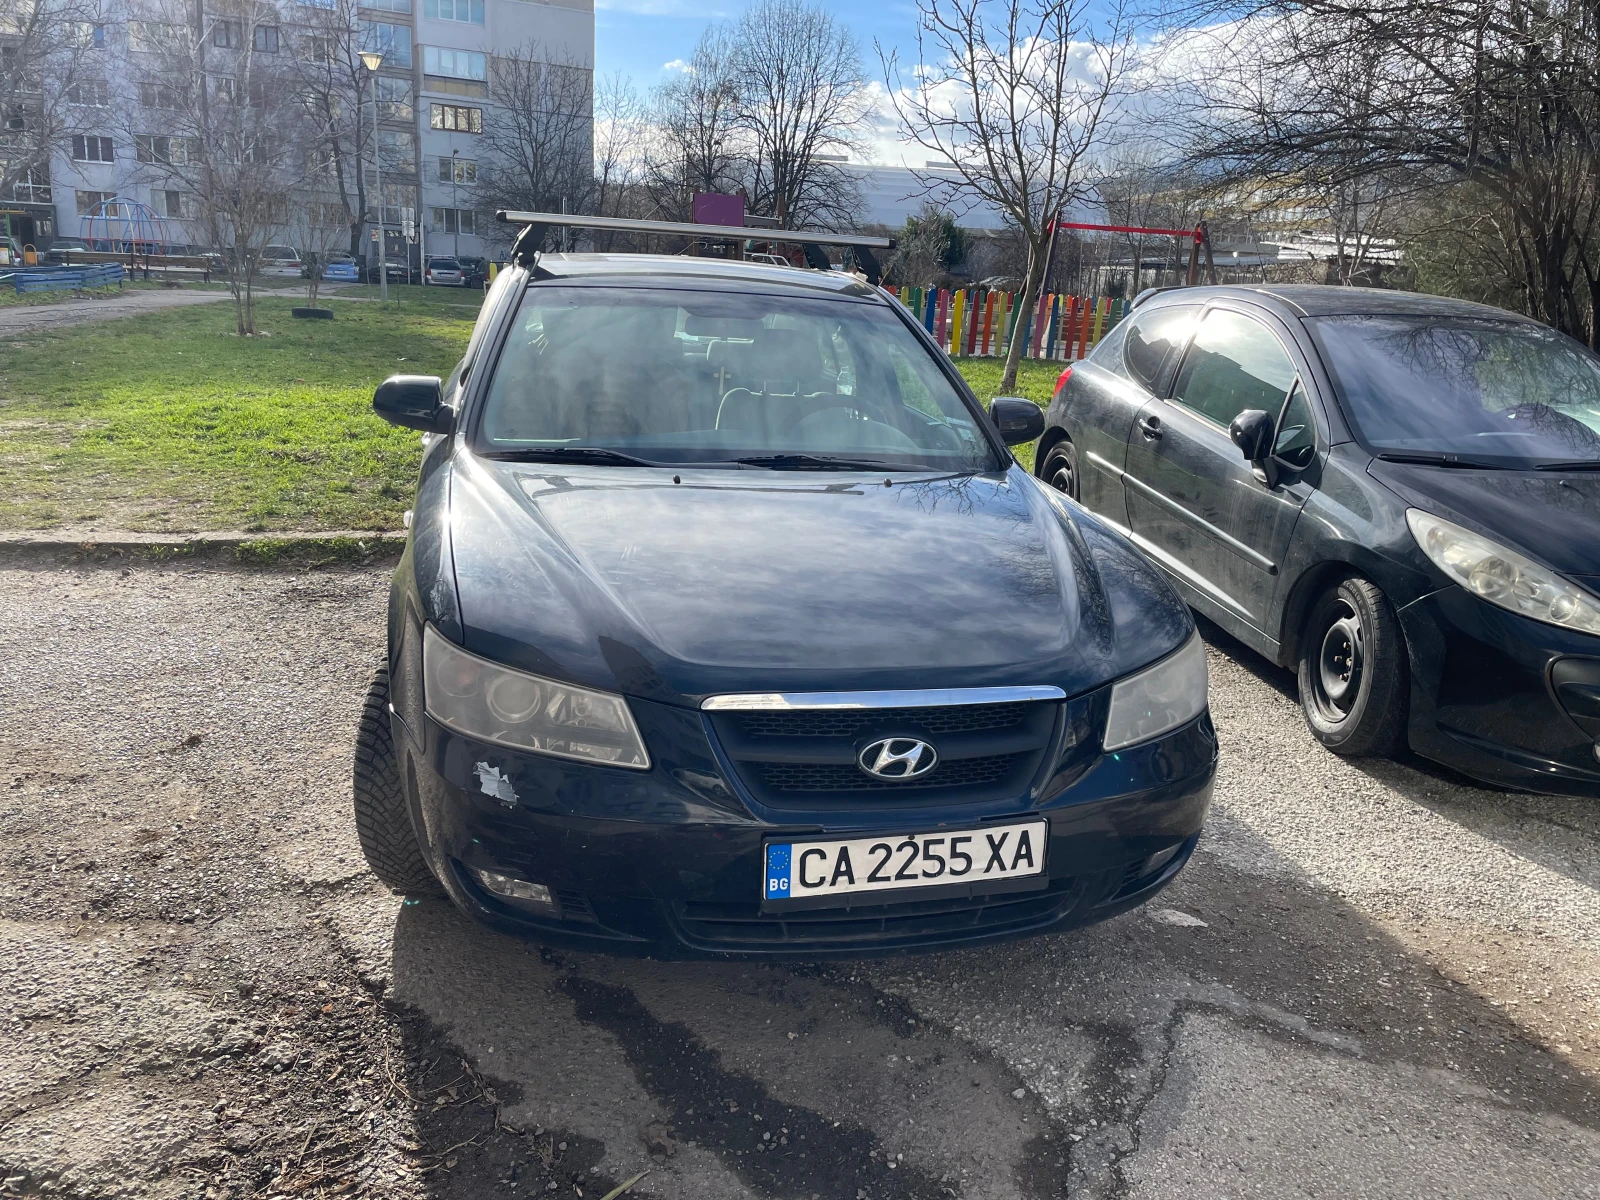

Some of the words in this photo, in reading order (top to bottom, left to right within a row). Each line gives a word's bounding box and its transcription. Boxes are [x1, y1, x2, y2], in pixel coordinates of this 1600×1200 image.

[799, 846, 856, 888] CA
[867, 836, 973, 882] 2255
[983, 830, 1035, 874] XA
[769, 877, 789, 891] BG
